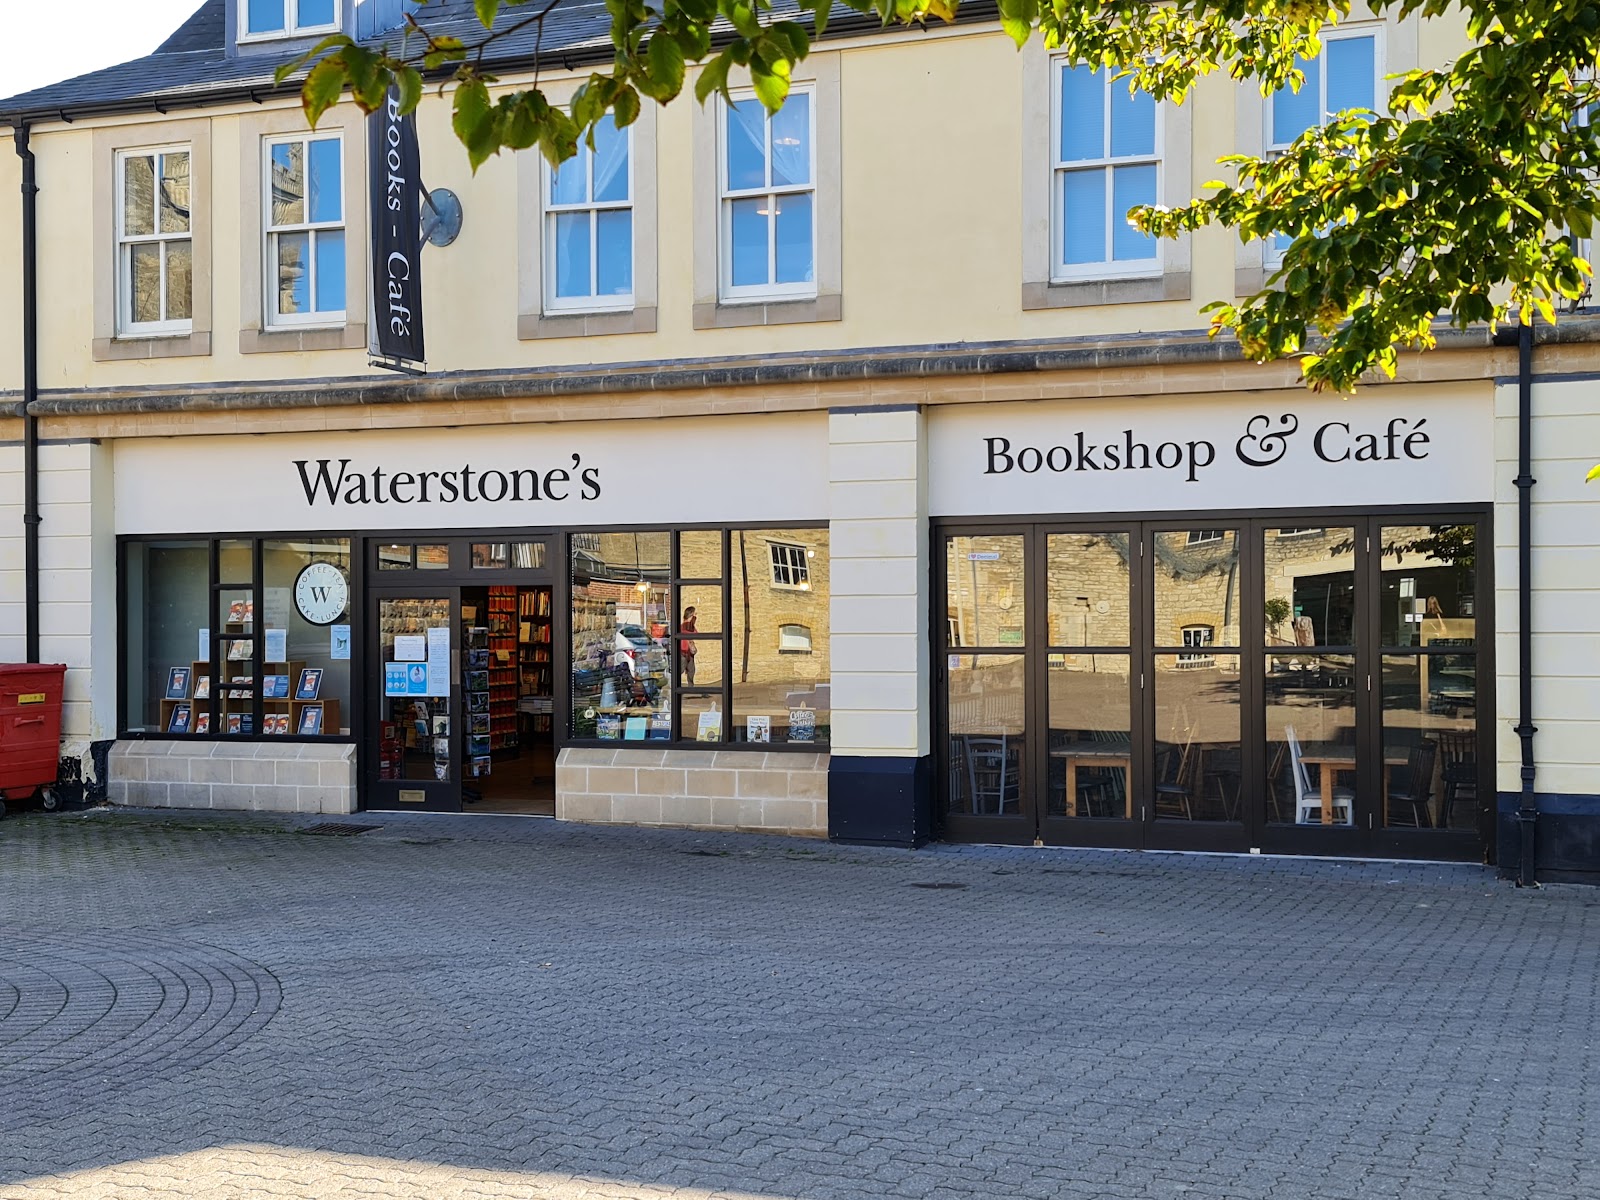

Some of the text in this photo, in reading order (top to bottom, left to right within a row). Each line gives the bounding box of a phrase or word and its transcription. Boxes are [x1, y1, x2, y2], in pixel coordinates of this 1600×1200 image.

[387, 94, 406, 212] Books
[387, 251, 411, 338] Café
[983, 413, 1431, 482] Bookshop & Café
[292, 452, 602, 506] Waterstone's
[298, 566, 344, 590] COFFEE TEA
[310, 586, 332, 604] W
[298, 597, 315, 620] CAKE
[320, 596, 345, 622] LUNCH
